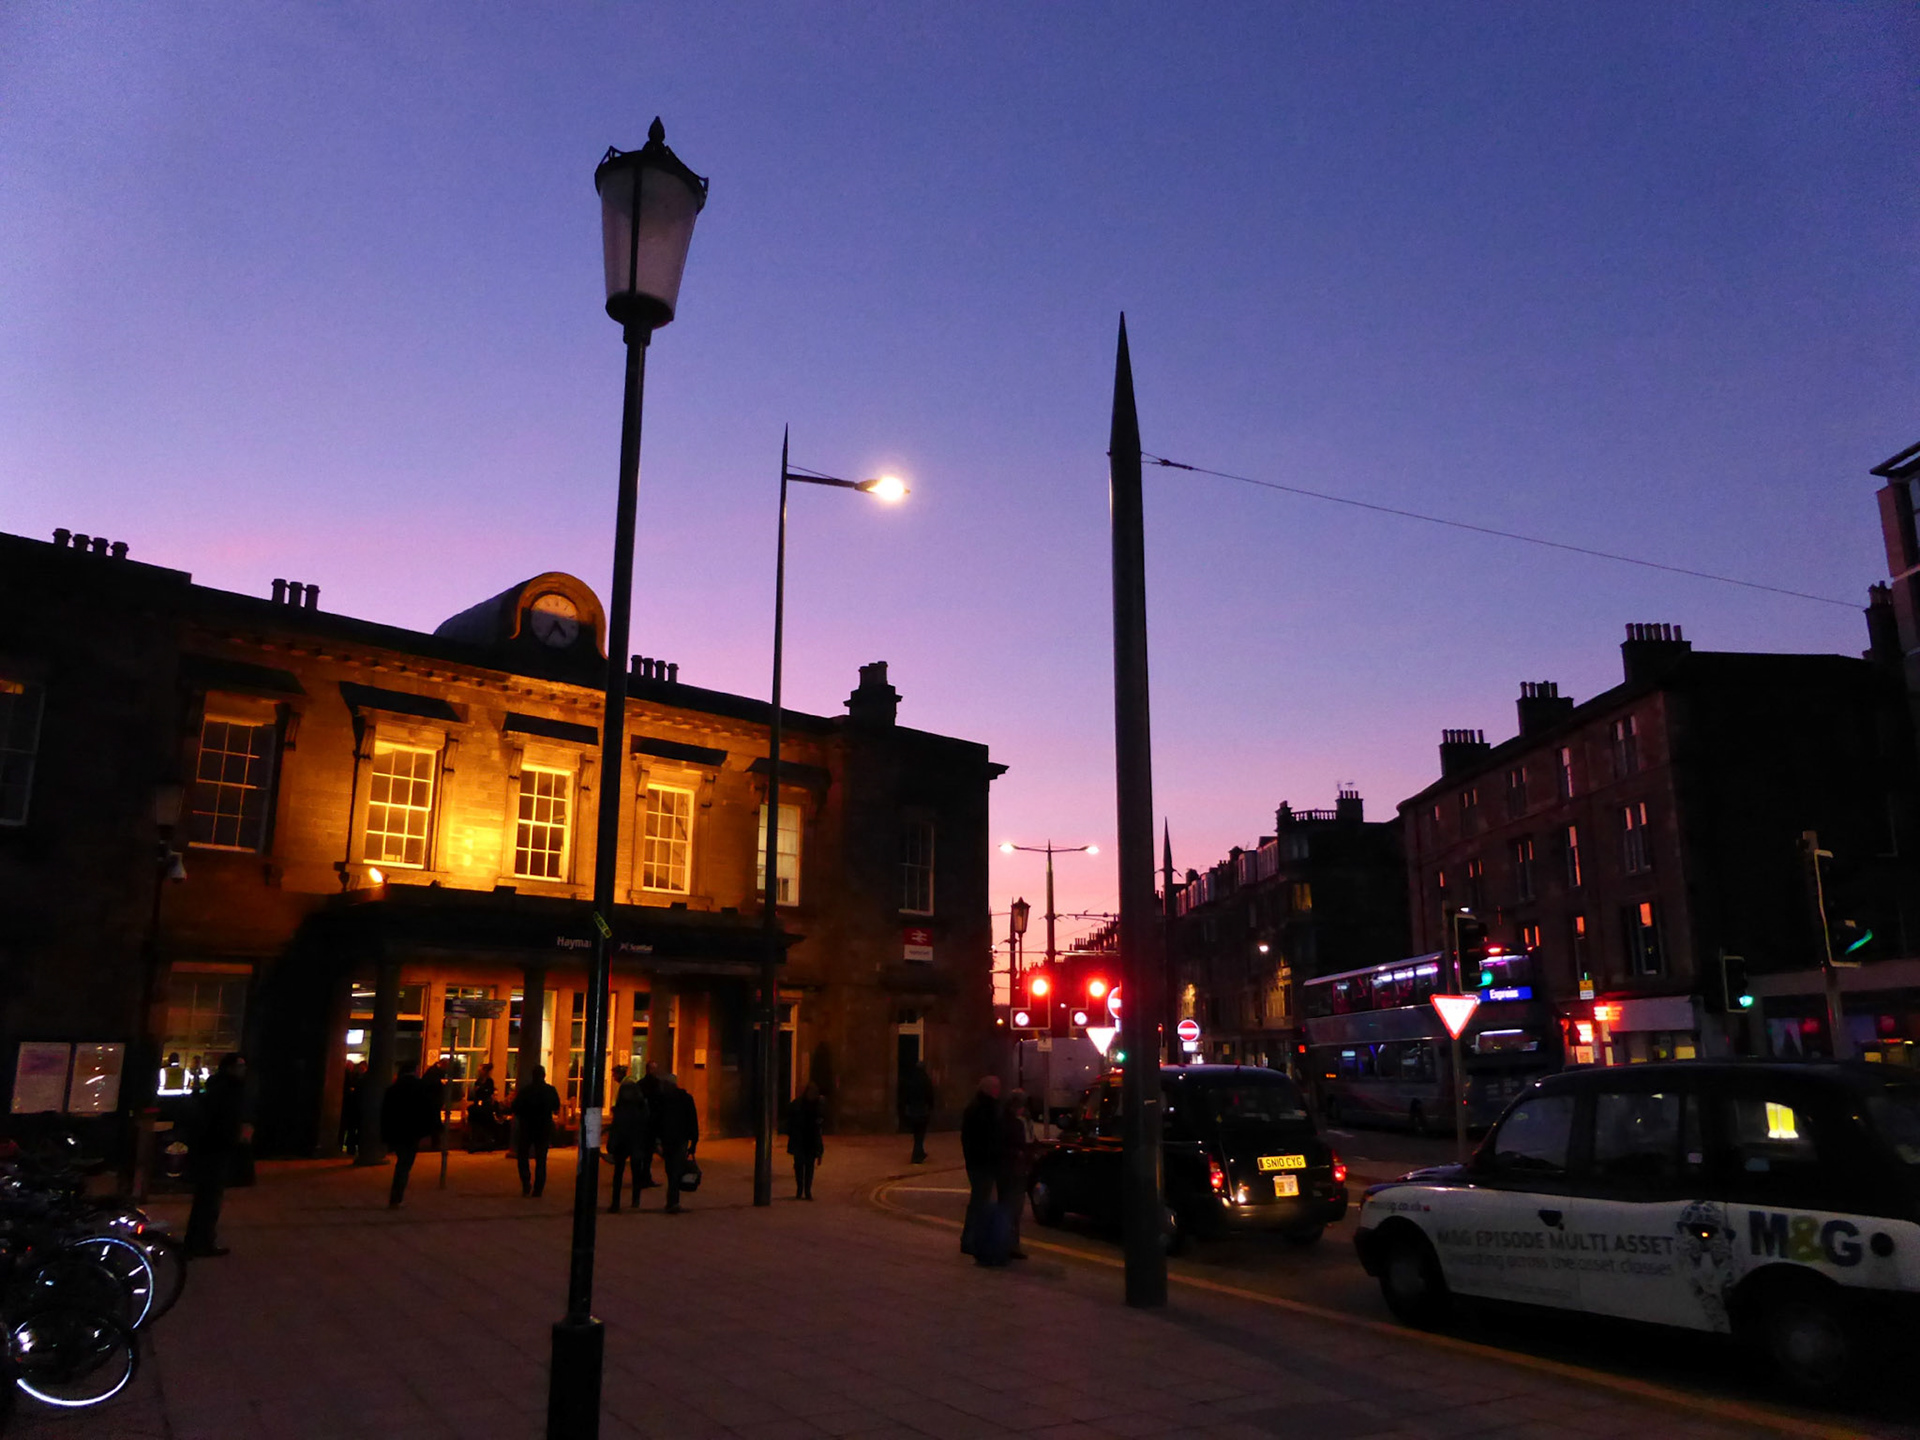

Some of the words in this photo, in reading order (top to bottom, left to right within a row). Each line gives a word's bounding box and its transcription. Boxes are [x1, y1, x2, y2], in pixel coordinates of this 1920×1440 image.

[1265, 1157, 1285, 1168] SN10
[1476, 1231, 1544, 1249] EPISODE
[1549, 1232, 1608, 1252] MULTI
[1614, 1234, 1674, 1255] ASSET
[1749, 1211, 1863, 1267] M&G
